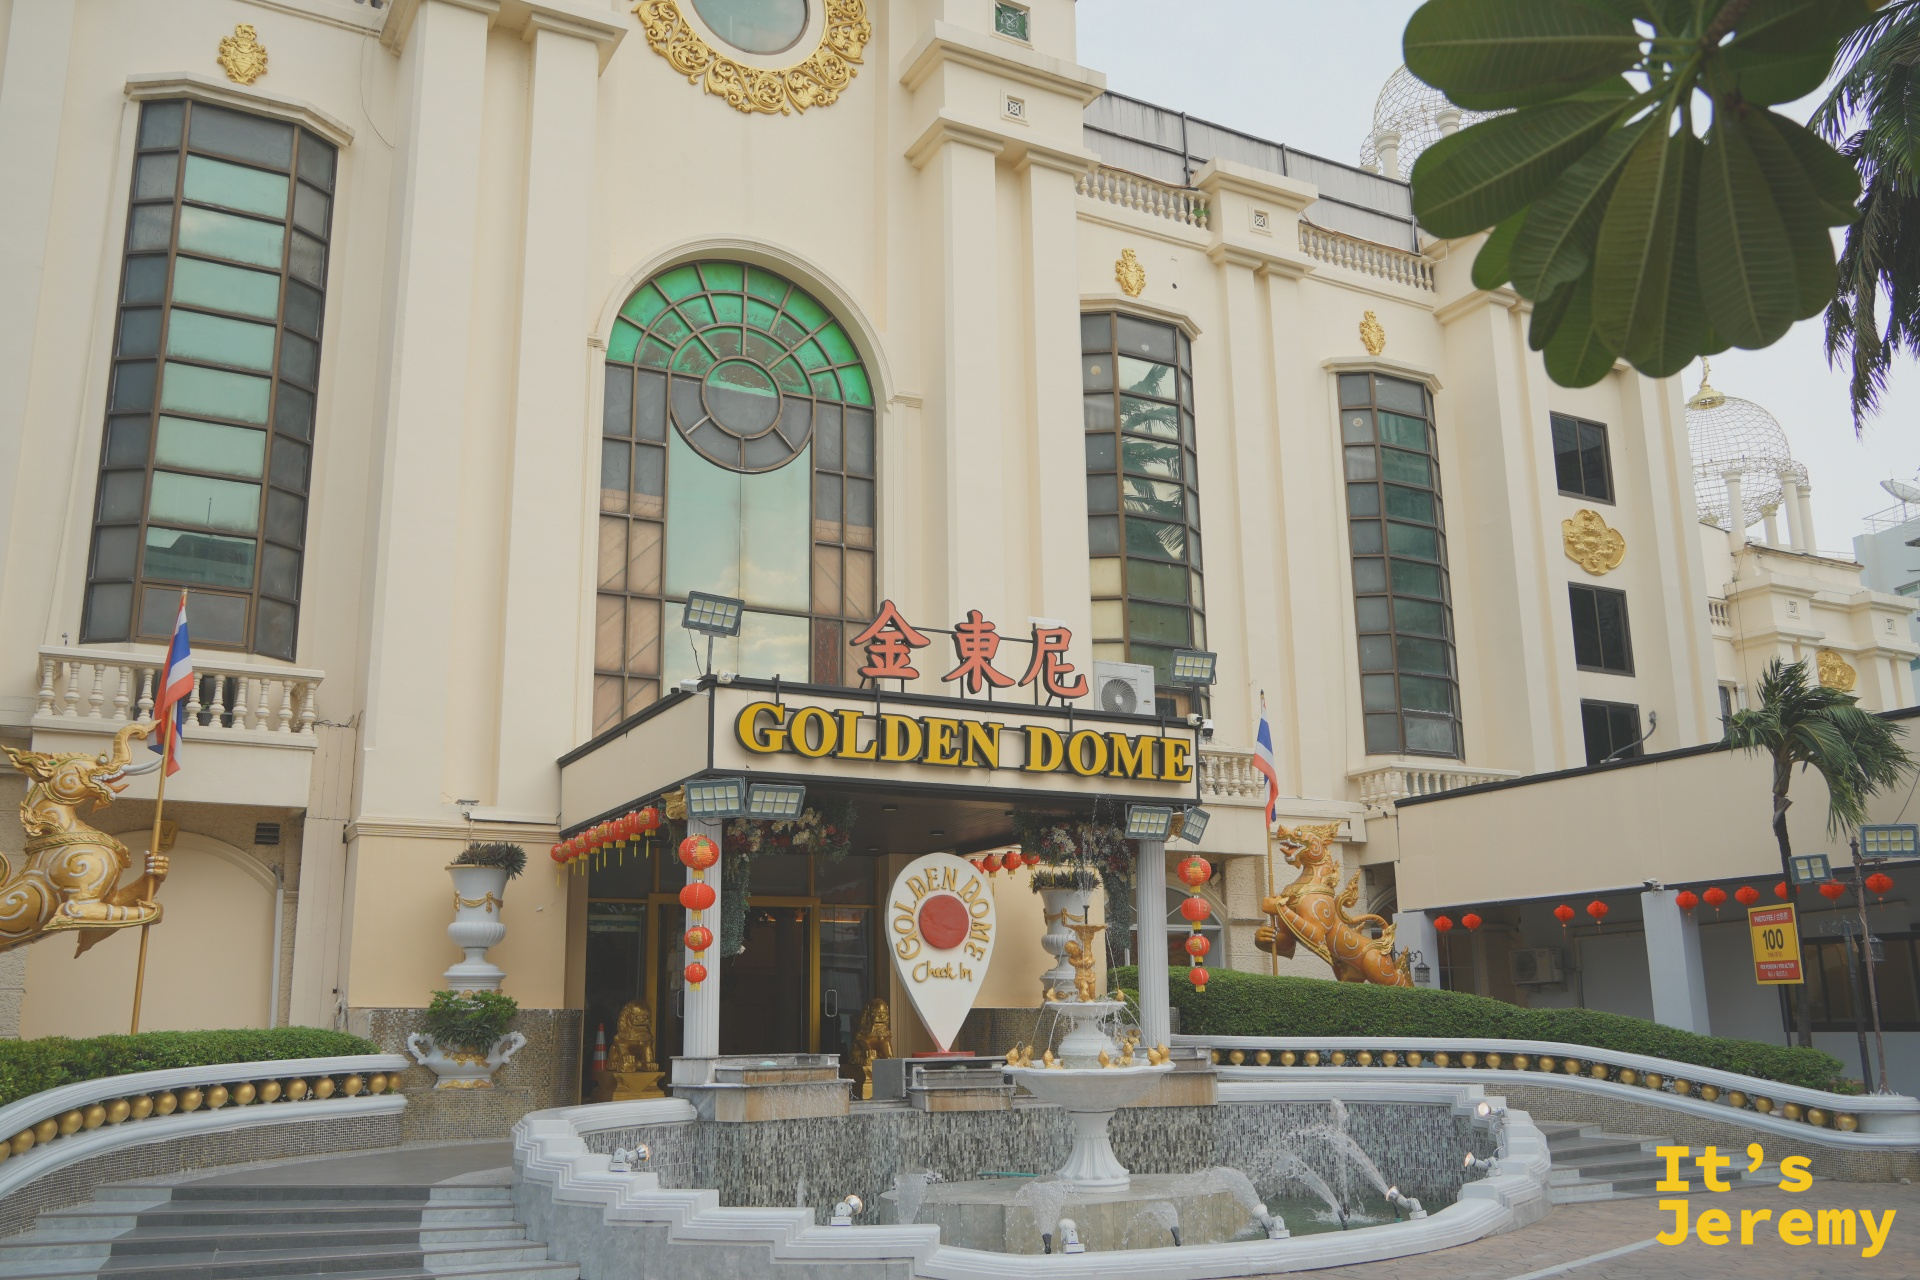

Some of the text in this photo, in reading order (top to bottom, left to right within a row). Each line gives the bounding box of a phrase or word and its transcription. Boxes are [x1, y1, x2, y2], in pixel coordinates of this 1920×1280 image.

[850, 599, 1089, 699] 金東尼
[735, 701, 1194, 783] GOLDEN DOME
[893, 866, 993, 961] GOLDEN DOME
[1762, 928, 1784, 950] 100
[913, 960, 957, 983] Check
